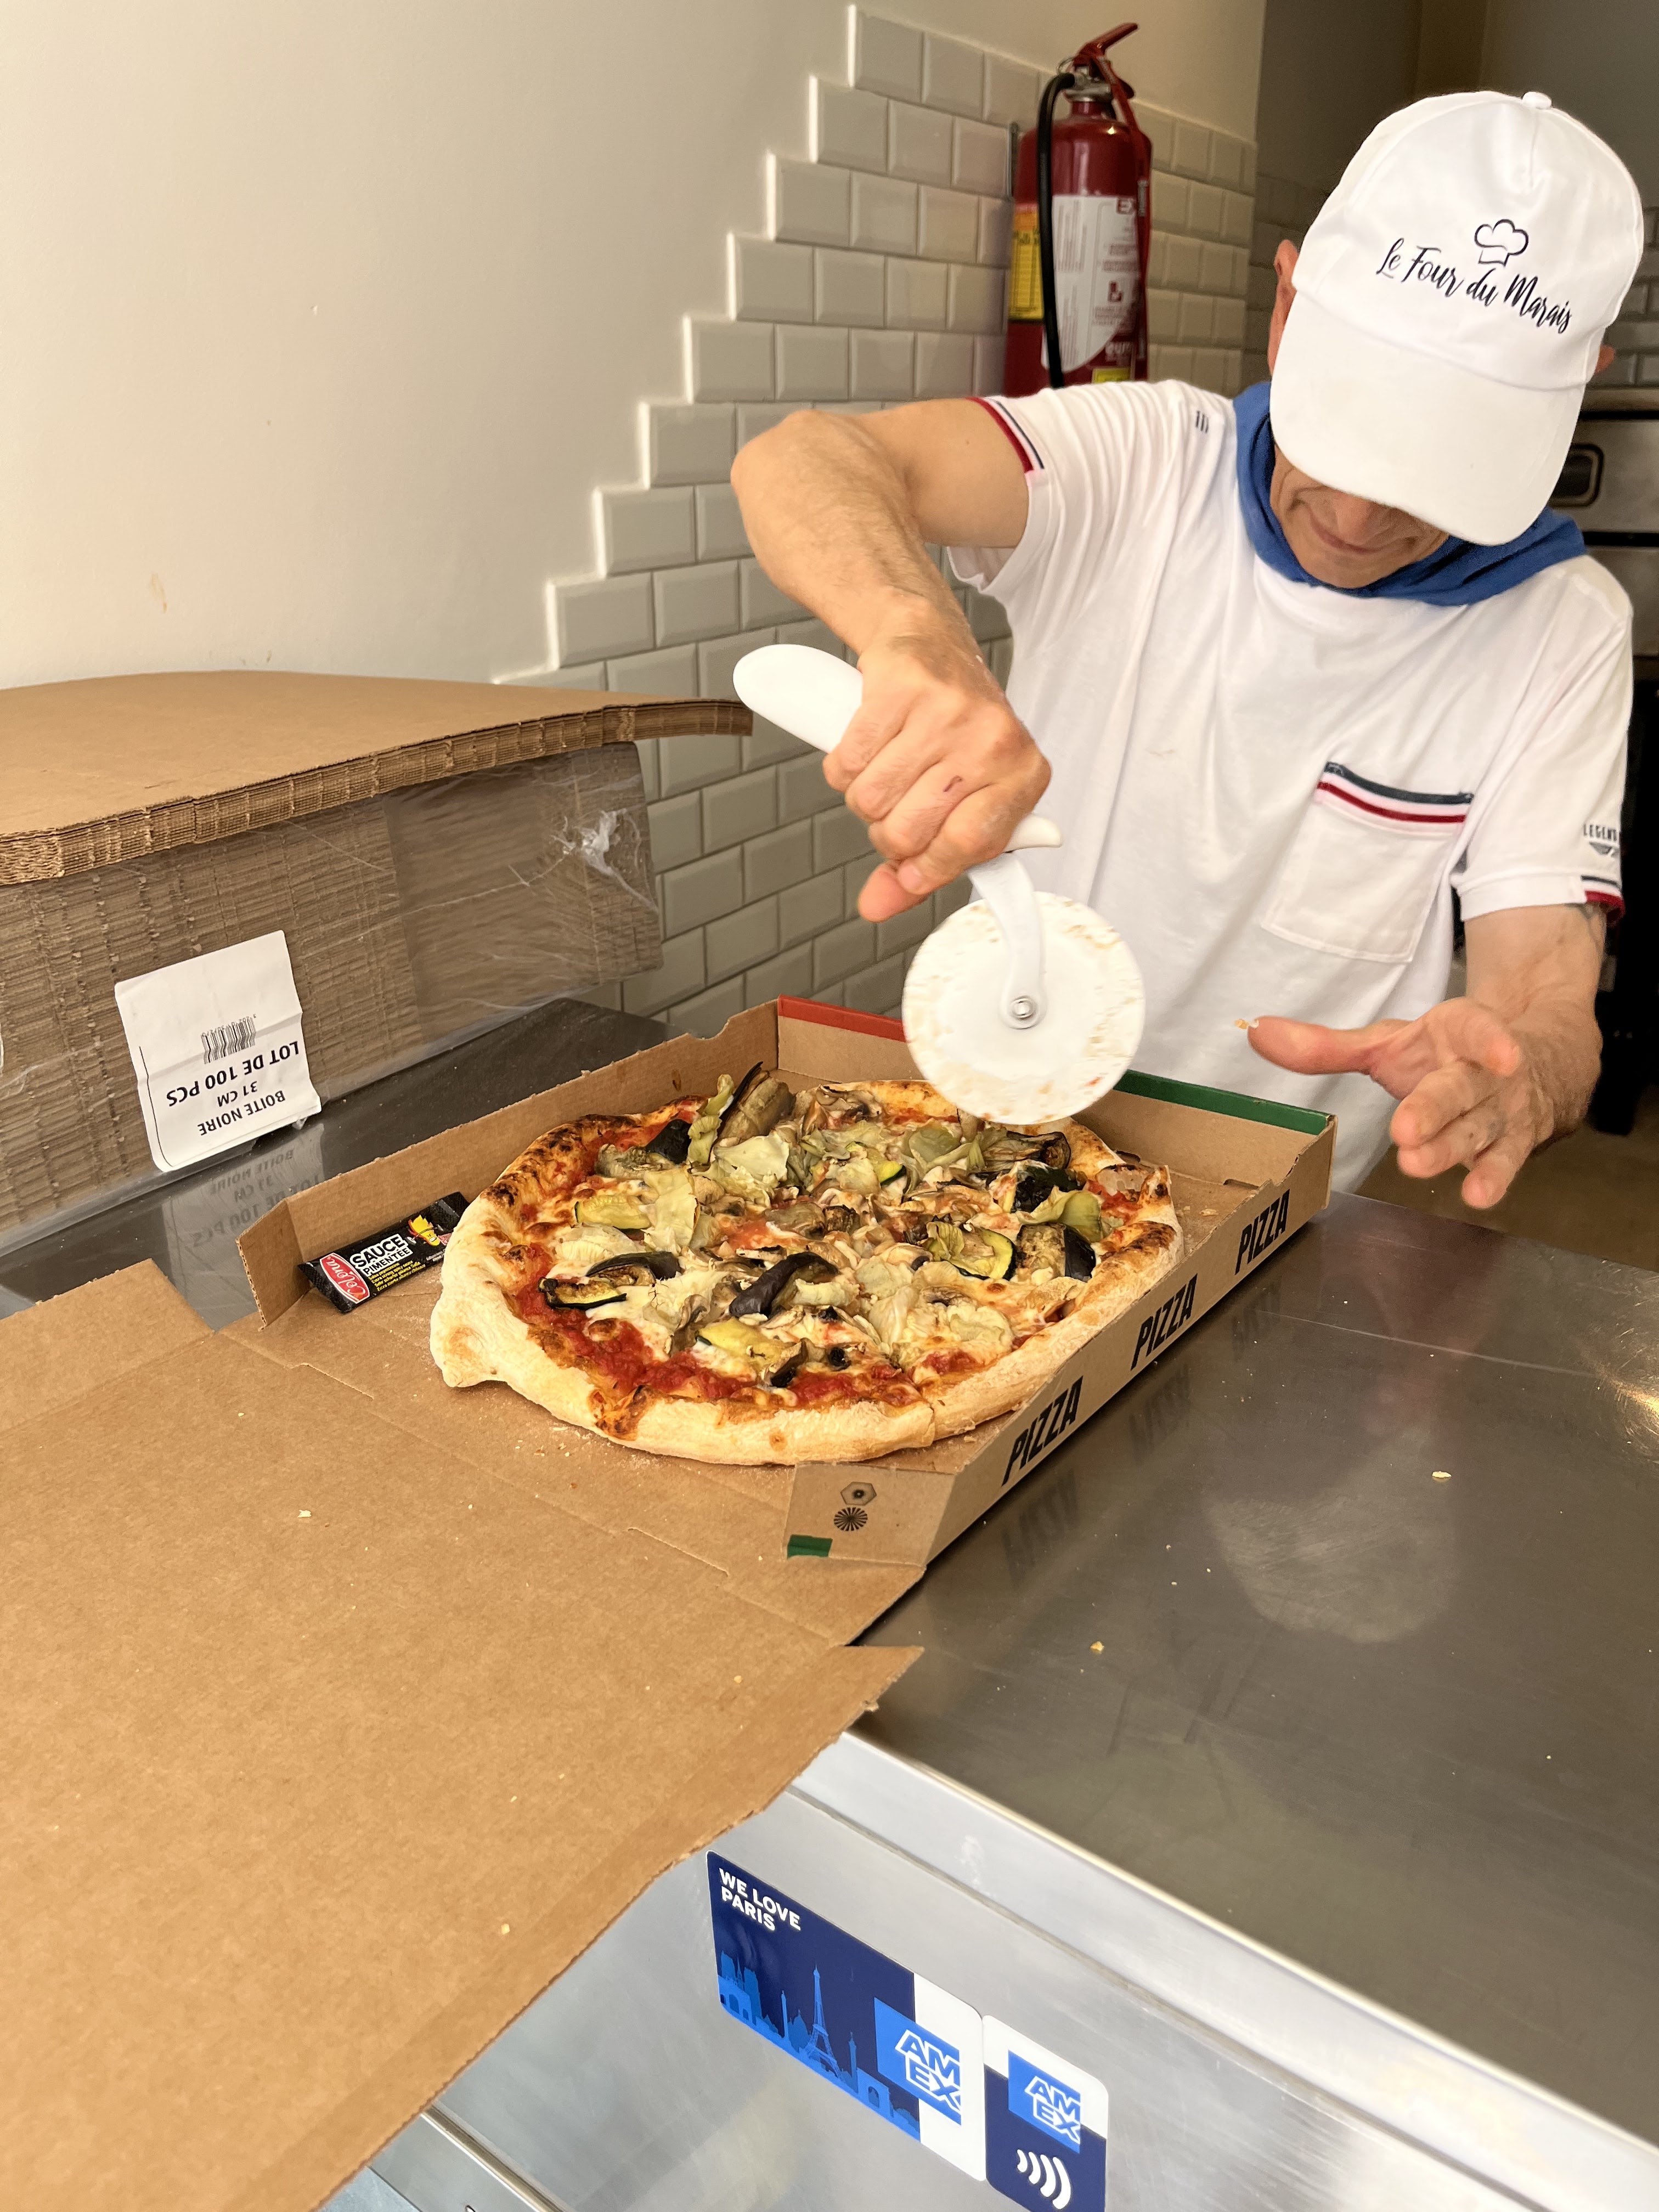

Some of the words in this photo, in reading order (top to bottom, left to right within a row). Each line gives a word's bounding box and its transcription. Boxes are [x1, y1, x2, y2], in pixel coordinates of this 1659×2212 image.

[1376, 238, 1404, 278] Le
[1401, 245, 1464, 297] Four
[1466, 267, 1498, 307] du
[1504, 273, 1572, 335] Marais
[242, 1054, 264, 1075] DE
[269, 1041, 300, 1065] LOT
[205, 1066, 238, 1090] 100
[243, 1081, 258, 1096] 31
[166, 1081, 200, 1107] PCS
[217, 1090, 238, 1107] CM
[244, 1090, 286, 1116] BOITE
[198, 1108, 243, 1136] NOIRE
[352, 1236, 405, 1267] SAUCE
[363, 1248, 411, 1275] PIMENTÉE
[328, 1261, 366, 1295] Colona
[1002, 1375, 1084, 1487] PIZZA
[1130, 1273, 1198, 1371] PIZZA
[1235, 1189, 1290, 1275] PIZZA
[719, 1867, 748, 1898] WE
[752, 1888, 801, 1931] LOVE
[721, 1886, 775, 1931] PARIS
